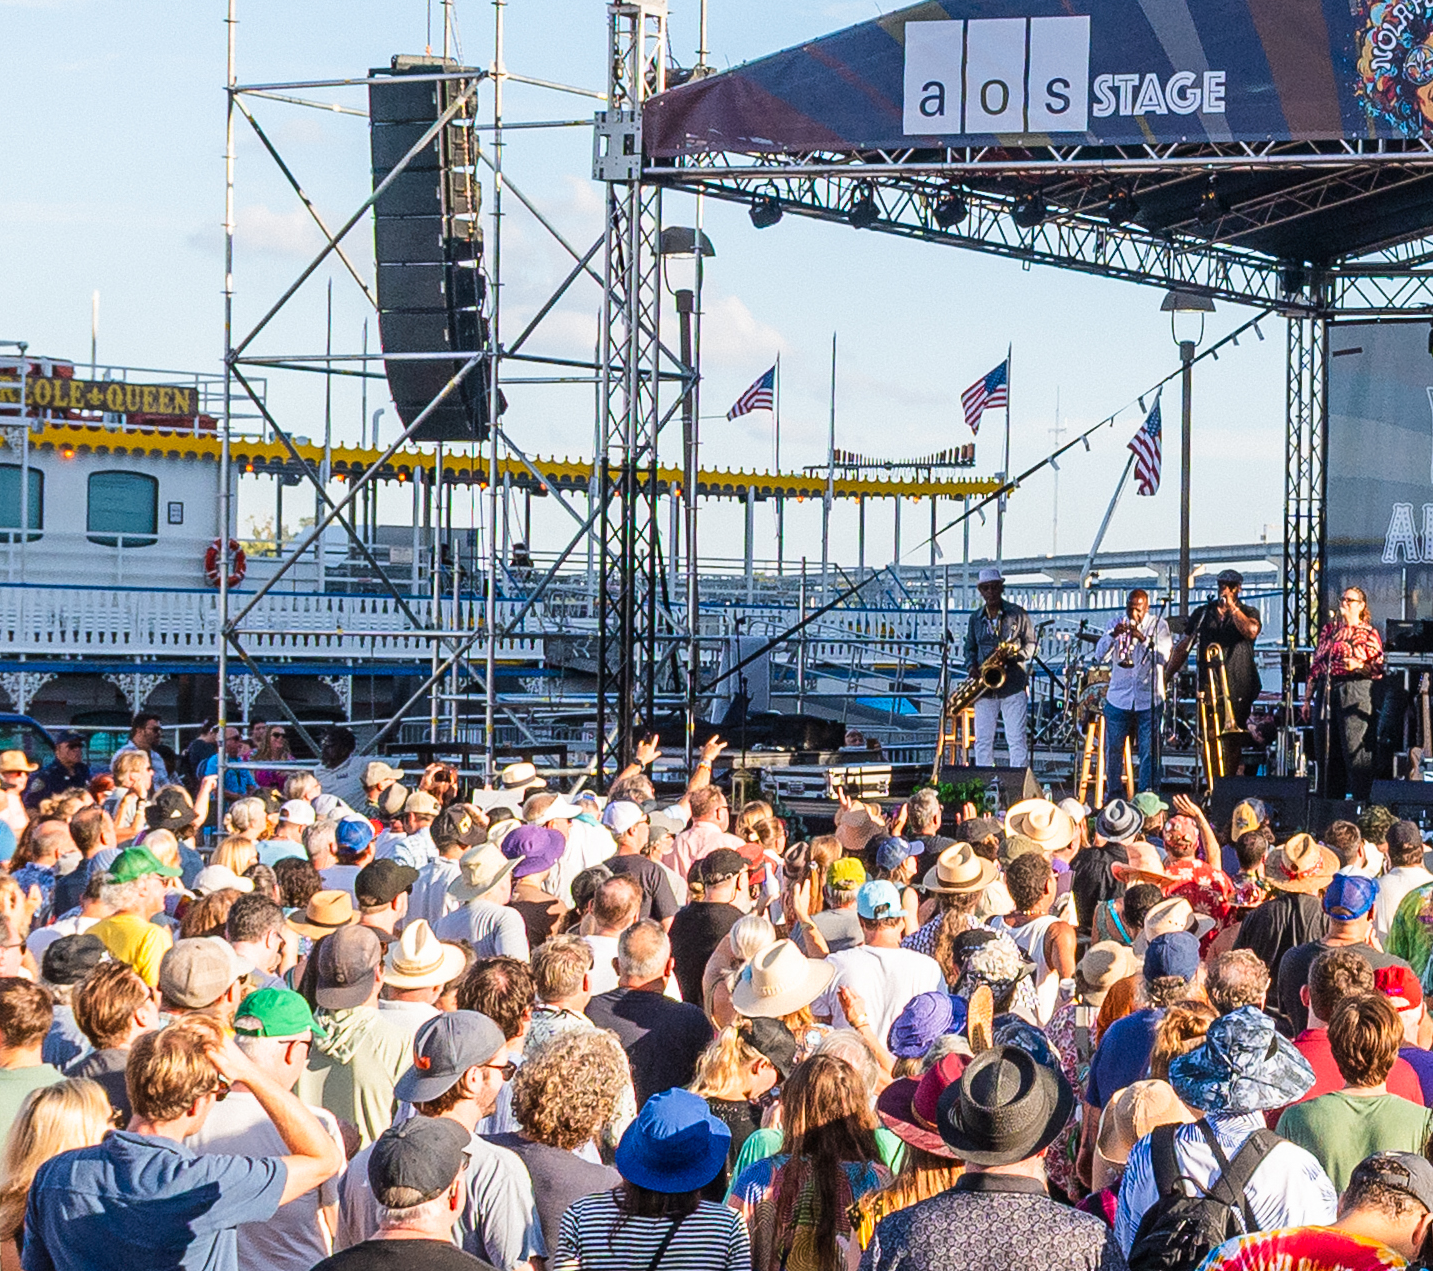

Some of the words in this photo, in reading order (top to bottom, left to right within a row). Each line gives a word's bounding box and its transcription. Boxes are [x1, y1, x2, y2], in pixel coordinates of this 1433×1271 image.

[1371, 4, 1414, 70] NOLA
[918, 75, 1071, 118] aos
[1092, 70, 1227, 118] STAGE
[104, 383, 191, 415] QUEEN
